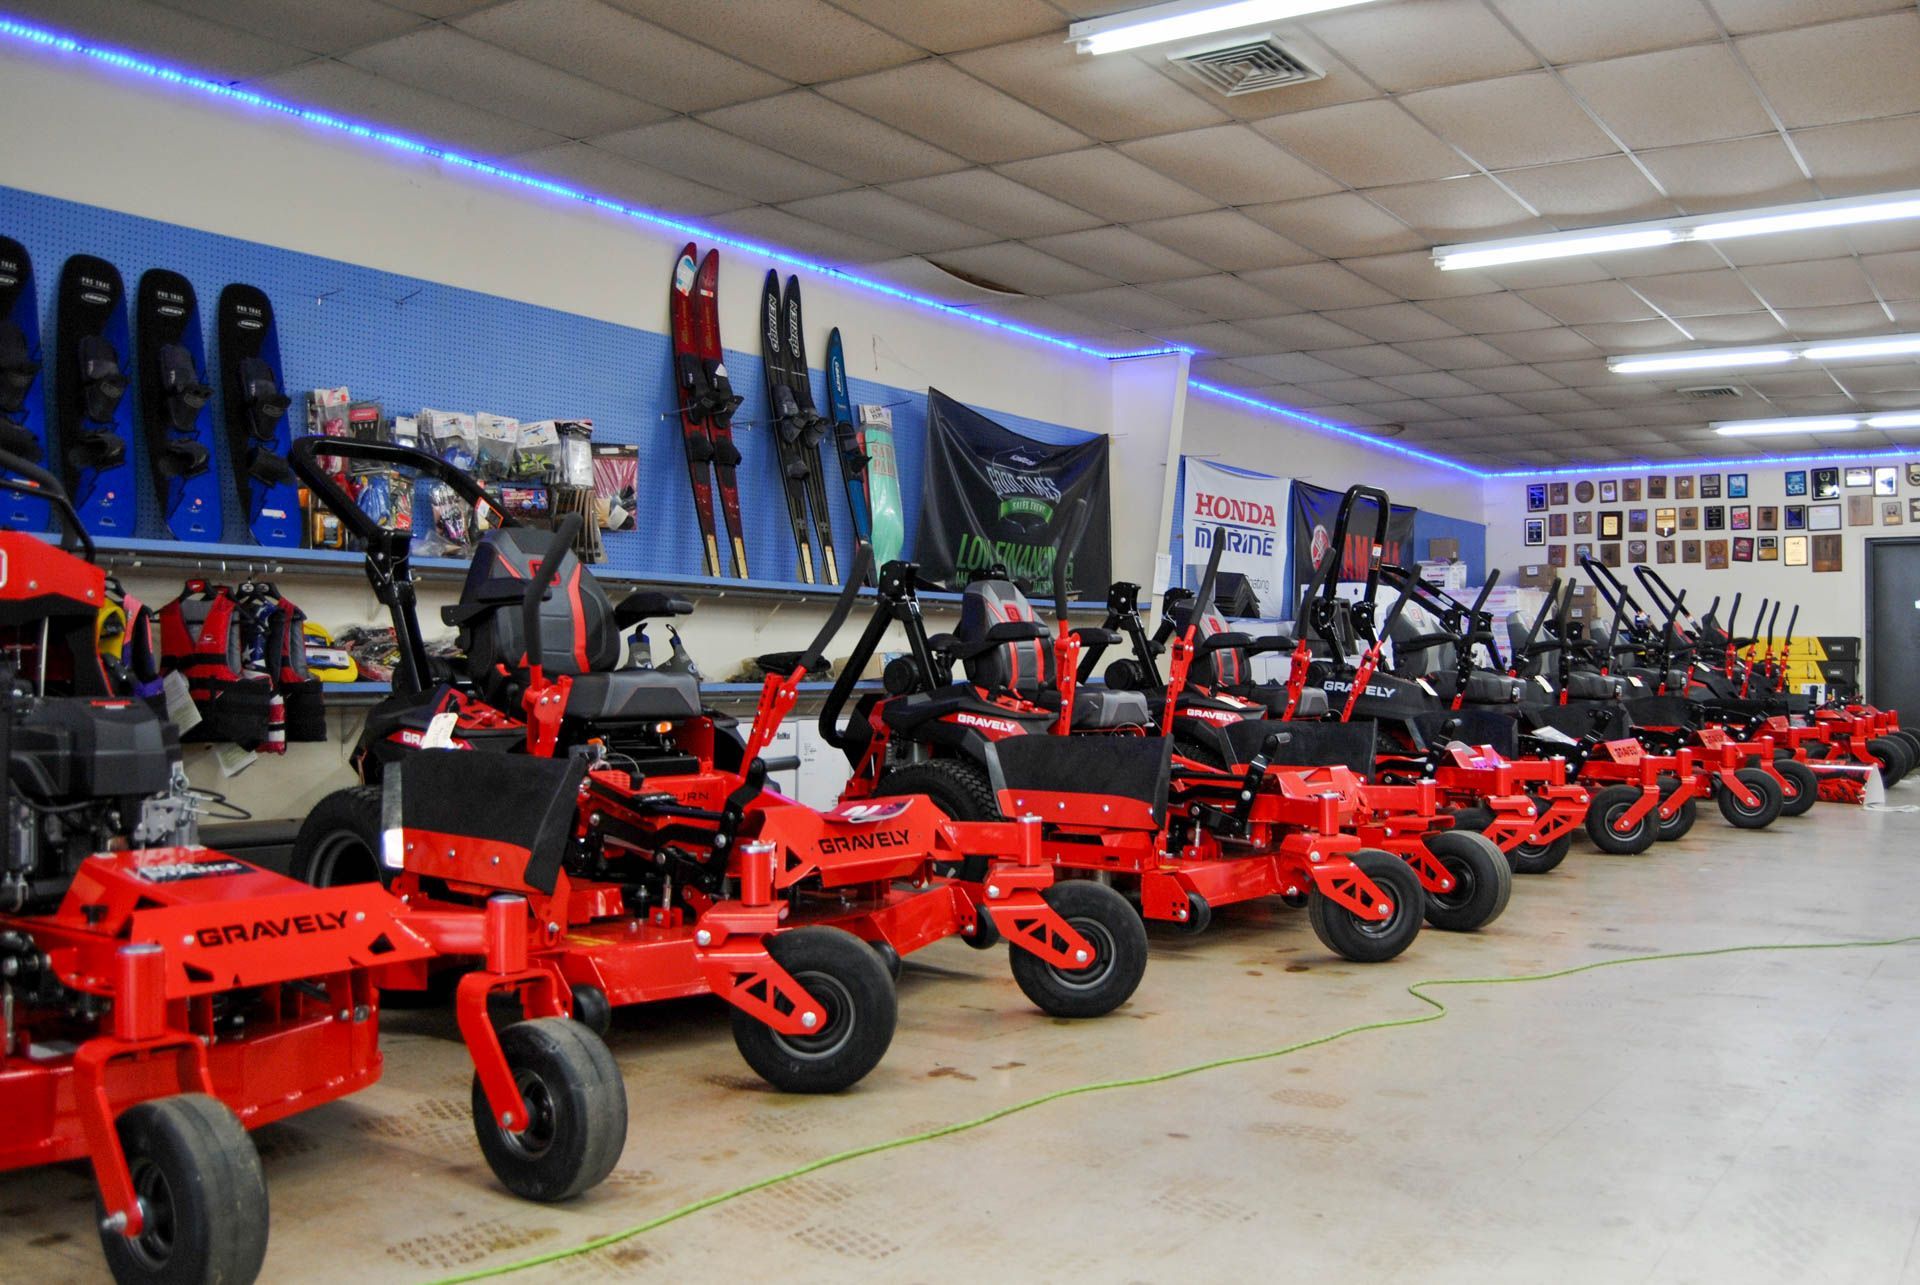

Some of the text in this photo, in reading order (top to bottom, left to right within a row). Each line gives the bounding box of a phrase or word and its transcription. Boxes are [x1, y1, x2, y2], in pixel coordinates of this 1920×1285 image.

[1195, 493, 1276, 527] HONDA
[1195, 527, 1274, 557] MRINE
[1323, 681, 1396, 698] GRAELY
[957, 713, 1016, 733] GRAVELY
[1186, 708, 1236, 723] GRAVELY
[818, 829, 910, 855] GRAVELY
[196, 910, 348, 948] GRAVELY
